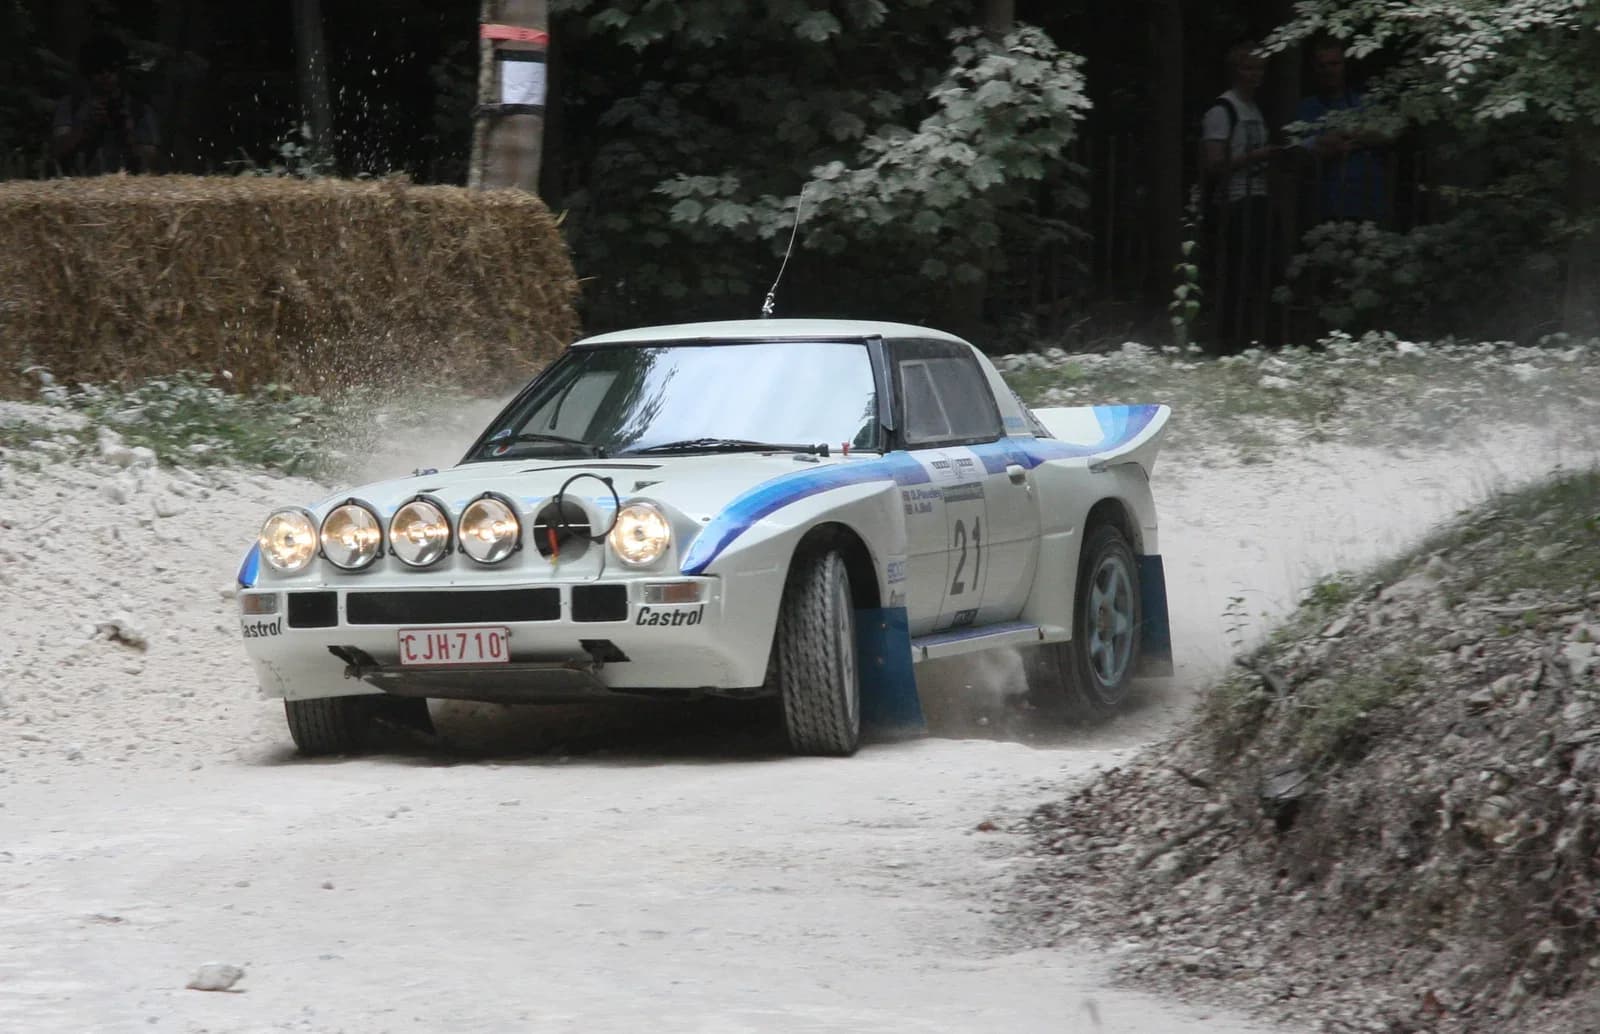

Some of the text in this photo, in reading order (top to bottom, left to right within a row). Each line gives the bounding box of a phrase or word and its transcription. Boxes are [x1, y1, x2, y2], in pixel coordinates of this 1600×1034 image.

[951, 516, 980, 595] 21
[636, 604, 704, 626] Castrol
[241, 616, 282, 638] astrol
